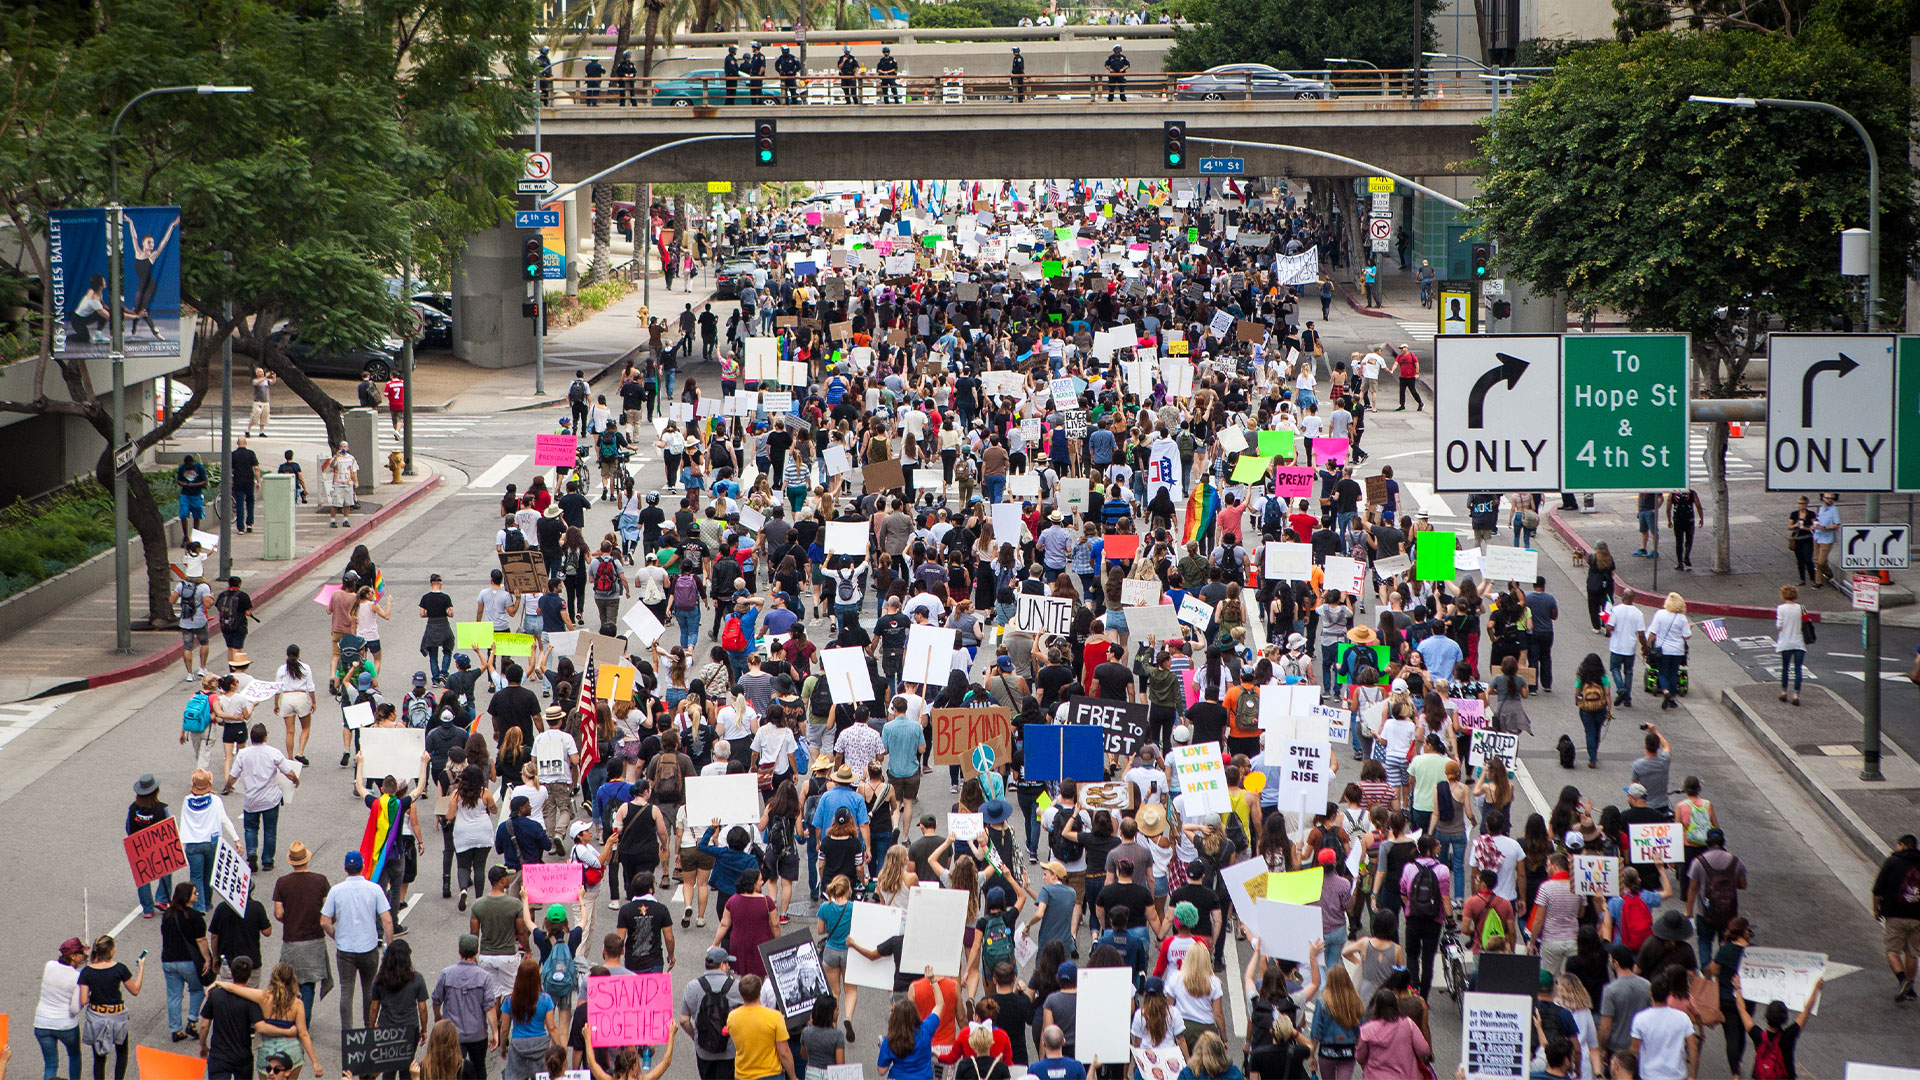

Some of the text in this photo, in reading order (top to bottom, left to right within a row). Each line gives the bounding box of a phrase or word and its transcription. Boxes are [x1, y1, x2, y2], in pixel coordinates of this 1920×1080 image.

[1203, 161, 1240, 170] 4th St
[520, 214, 556, 224] 4th St
[50, 216, 65, 352] LOS ANGELES BALLET
[1612, 350, 1639, 372] To
[394, 388, 400, 399] 7
[1575, 383, 1677, 411] Hope St
[1066, 411, 1086, 420] BLACK
[1066, 420, 1087, 429] LIVES
[1618, 418, 1633, 437] &
[1066, 429, 1087, 438] MATTER
[1447, 440, 1548, 472] ONLY
[1576, 440, 1670, 468] 4th St
[1776, 437, 1886, 474] ONLY
[1279, 473, 1312, 486] PREXIT
[1846, 558, 1904, 566] ONLY ONLY
[1126, 581, 1157, 589] DIVIDED
[1182, 601, 1194, 610] Love
[1018, 598, 1072, 635] UNITE
[1322, 708, 1342, 719] NOT
[1076, 704, 1144, 737] FREE TO
[937, 713, 1010, 756] BE KIND
[1181, 745, 1209, 758] LOVE
[1290, 746, 1320, 758] STILL
[1178, 760, 1221, 774] TRUMPS
[1298, 759, 1314, 770] WE
[1291, 771, 1319, 783] RISE
[1187, 780, 1218, 792] HATE
[132, 820, 177, 854] HUMAN
[1641, 825, 1671, 838] STOP
[1634, 837, 1672, 847] THE NEW
[136, 839, 186, 880] RIGHTS
[1641, 846, 1672, 860] HATE
[214, 842, 228, 888] RESIST
[222, 850, 234, 891] TRUMP
[524, 865, 550, 873] WHITE
[229, 856, 240, 901] POLICY
[527, 875, 536, 884] IS
[1585, 872, 1609, 882] NOT
[236, 878, 242, 892] OF
[240, 873, 248, 909] HATE
[1581, 882, 1611, 894] HATE
[596, 979, 658, 1010] STAND
[1480, 1010, 1492, 1018] the
[1496, 1011, 1518, 1020] Name
[590, 1009, 672, 1041] TOGETHER
[346, 1028, 407, 1046] MY BODY
[1486, 1032, 1520, 1042] REFUSE
[348, 1047, 412, 1064] MY CHOICE
